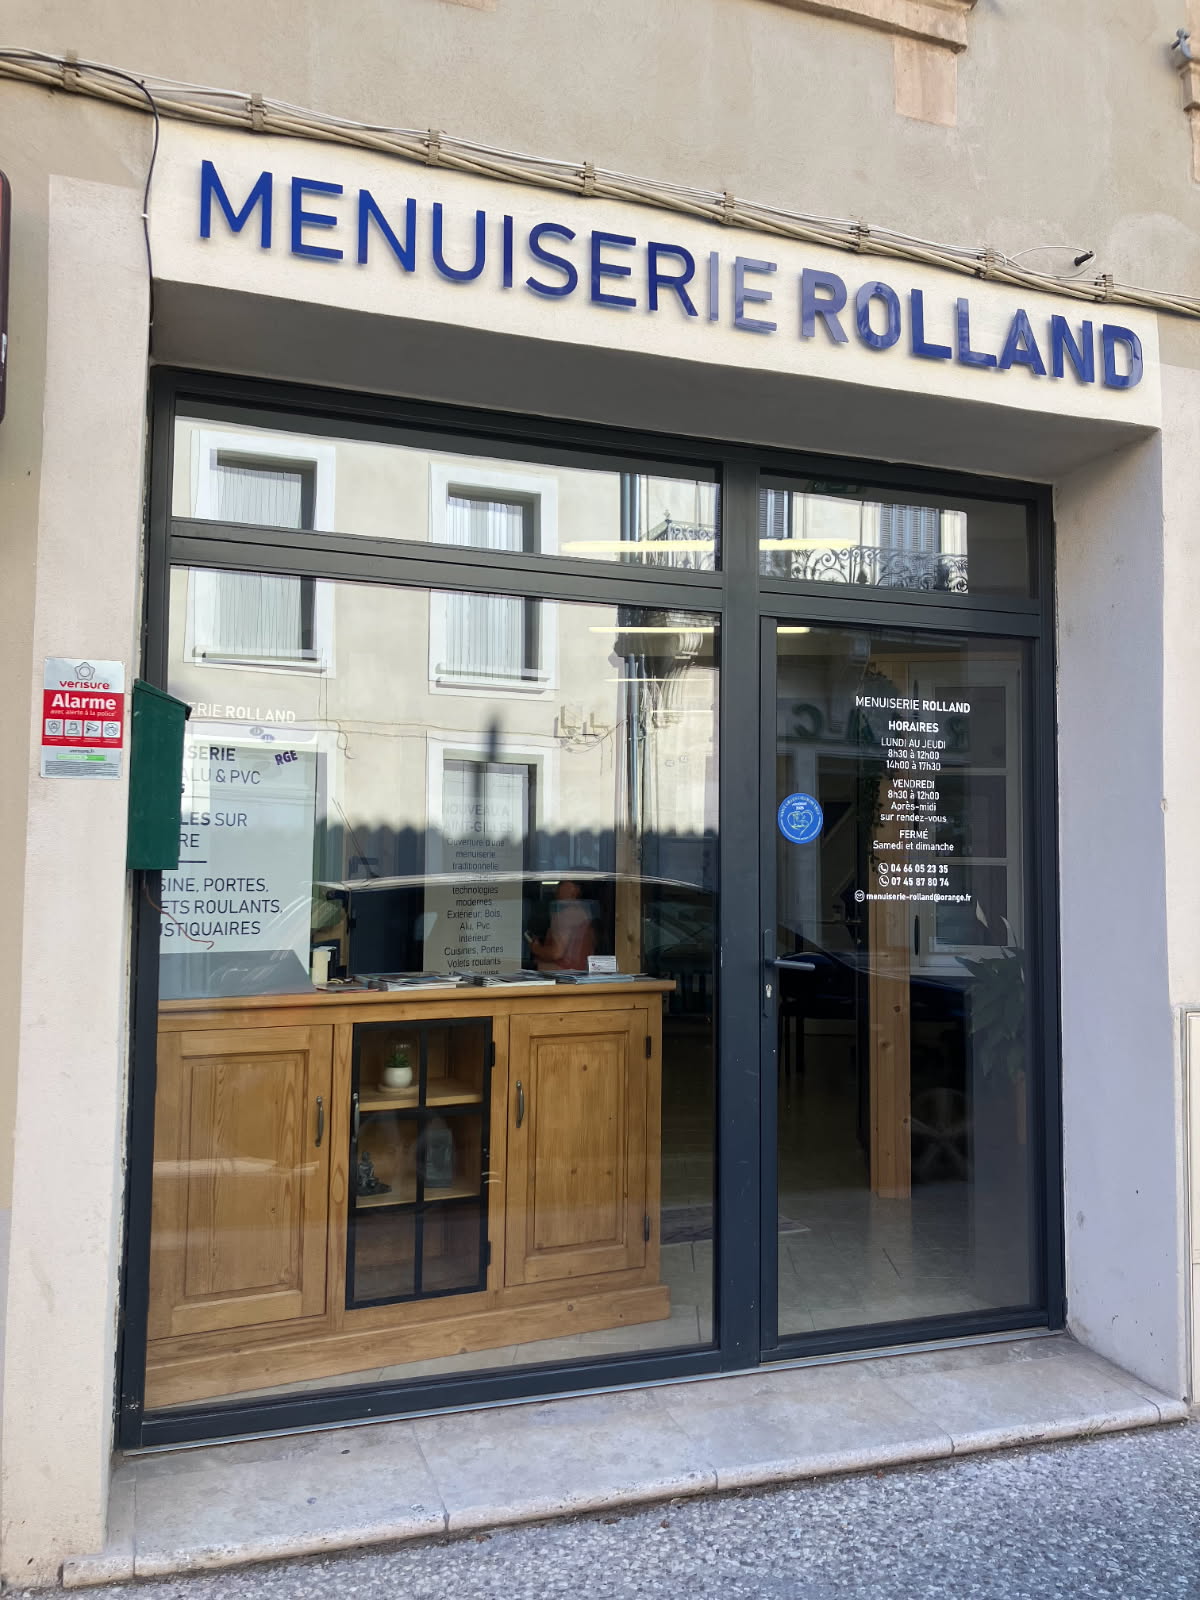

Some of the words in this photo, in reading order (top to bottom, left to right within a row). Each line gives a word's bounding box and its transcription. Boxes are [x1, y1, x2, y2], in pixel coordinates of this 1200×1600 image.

[199, 160, 778, 332] MENUISERIE
[801, 268, 1144, 389] ROLLAND
[59, 680, 110, 690] verisure
[51, 692, 117, 710] Alarme
[855, 695, 920, 711] MENUISERIE
[922, 699, 971, 714] ROLLAND
[225, 705, 296, 724] ROLLAND
[888, 720, 939, 733] HORAIRES
[881, 737, 907, 748] LUNDI
[908, 738, 921, 749] AU
[921, 739, 946, 750] JEUDI
[274, 750, 299, 766] RGE
[887, 748, 908, 759] 8h30
[909, 749, 915, 759] à
[917, 750, 940, 760] 12h00
[886, 759, 910, 770] 14h00
[911, 760, 917, 770] à
[918, 761, 941, 771] 17h30
[215, 768, 226, 783] &
[230, 769, 261, 785] PVC
[892, 778, 935, 790] VENDREDI
[887, 790, 908, 800] 8h30
[909, 790, 915, 800] à
[917, 790, 940, 801] 12h00
[890, 800, 937, 812] Après-midi
[214, 812, 248, 827] SUR
[880, 813, 895, 822] sur
[896, 813, 947, 823] rendez-vous
[899, 828, 929, 840] FERMÉ
[447, 836, 484, 847] Ouverture
[872, 840, 904, 850] Samedi
[905, 841, 914, 851] et
[915, 841, 954, 852] dimanche
[455, 849, 497, 859] menuiserie
[452, 861, 499, 871] traditionnelle
[890, 863, 902, 873] 04
[903, 863, 913, 873] 66
[914, 863, 926, 873] 05
[926, 864, 937, 874] 23
[938, 864, 949, 874] 35
[891, 876, 901, 886] 07
[915, 877, 926, 887] 87
[939, 878, 950, 887] 74
[452, 884, 499, 896] technologies
[456, 897, 493, 906] modernes
[866, 892, 972, 903] menuiserie-rolland@orange.fr
[160, 920, 261, 937] STIQUAIRES
[480, 944, 504, 954] Portes
[447, 957, 470, 969] Volets
[471, 957, 502, 967] roulants
